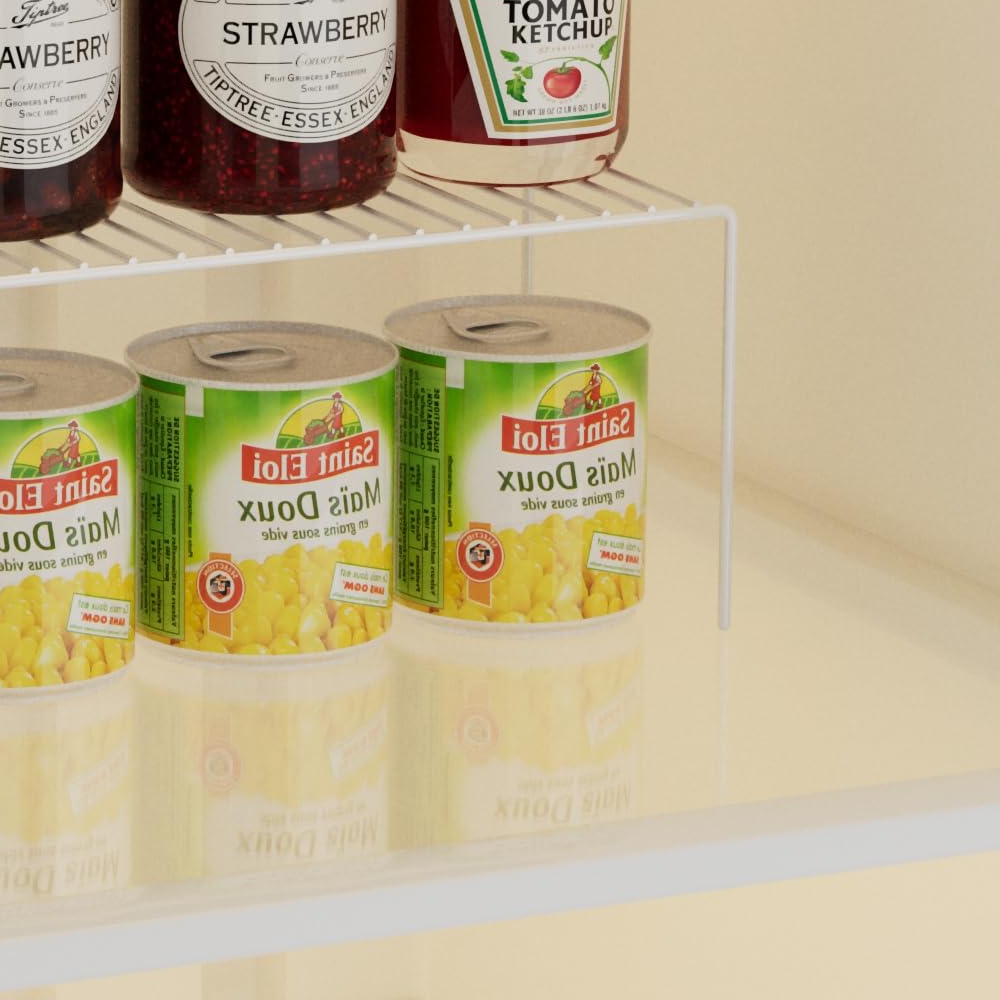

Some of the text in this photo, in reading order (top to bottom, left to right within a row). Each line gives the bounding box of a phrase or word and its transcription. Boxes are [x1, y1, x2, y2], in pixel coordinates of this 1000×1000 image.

[10, 0, 69, 28] Tiptree
[223, 8, 388, 46] STRAWBERRY
[511, 17, 613, 44] KETCHUP
[0, 135, 62, 154] ESSEX
[70, 72, 118, 144] ENGLAND
[203, 65, 274, 122] TIPTREE
[282, 109, 343, 128] ESSEX
